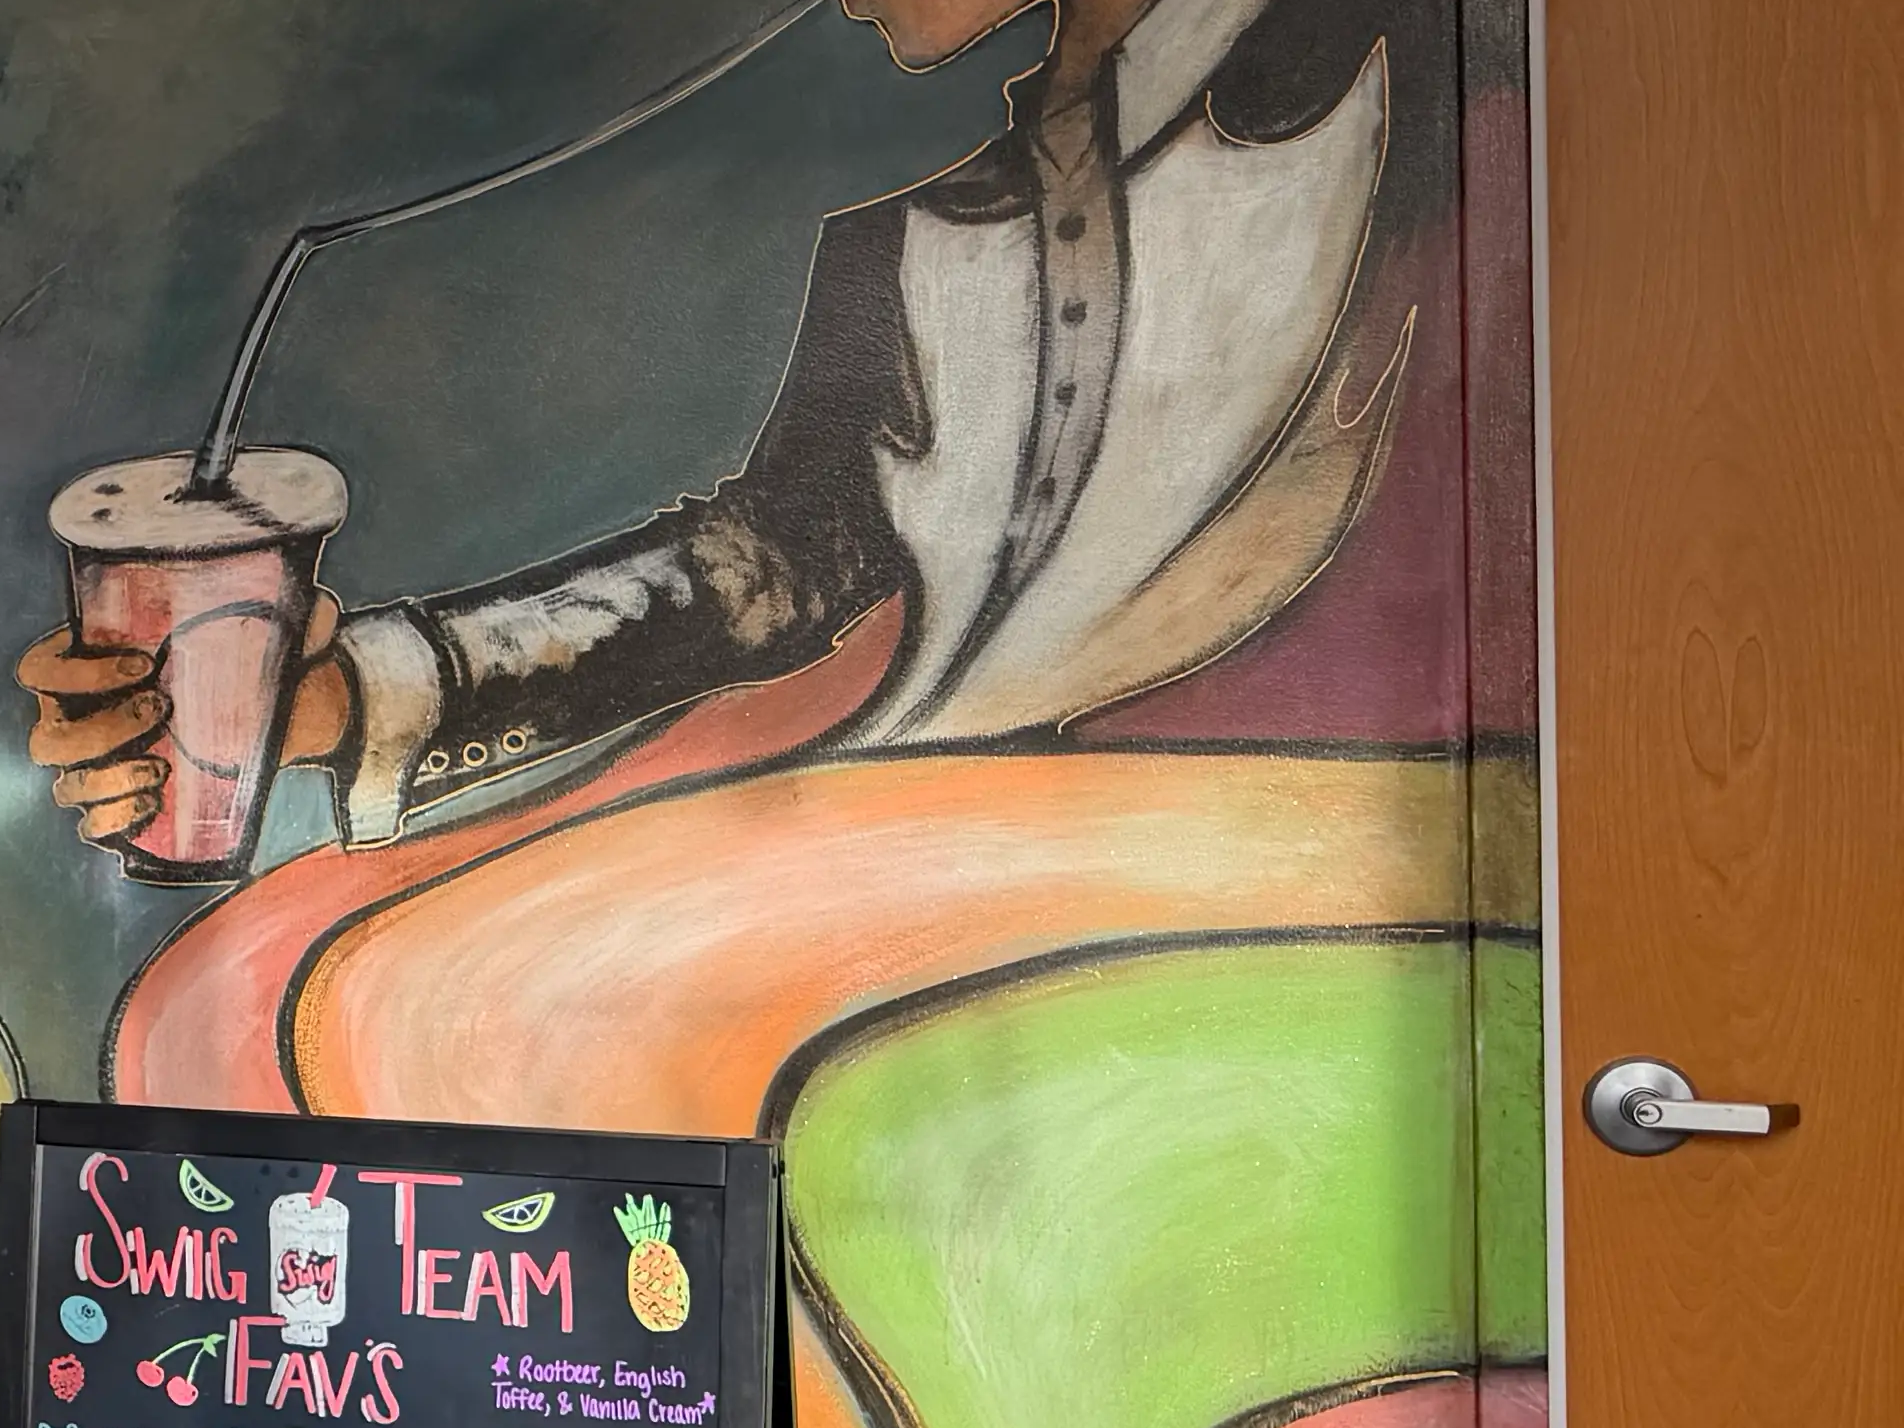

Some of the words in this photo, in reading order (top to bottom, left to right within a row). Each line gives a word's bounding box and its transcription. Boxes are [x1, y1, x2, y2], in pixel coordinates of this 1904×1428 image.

[75, 1152, 247, 1304] SWIG
[358, 1172, 573, 1333] TEAM
[278, 1251, 338, 1304] Swig
[519, 1355, 606, 1387] Rootbeer,
[615, 1362, 685, 1397] English
[492, 1382, 550, 1417] Toffee,
[558, 1394, 573, 1414] &
[580, 1394, 640, 1420] Vanilla
[649, 1399, 703, 1425] Cream
